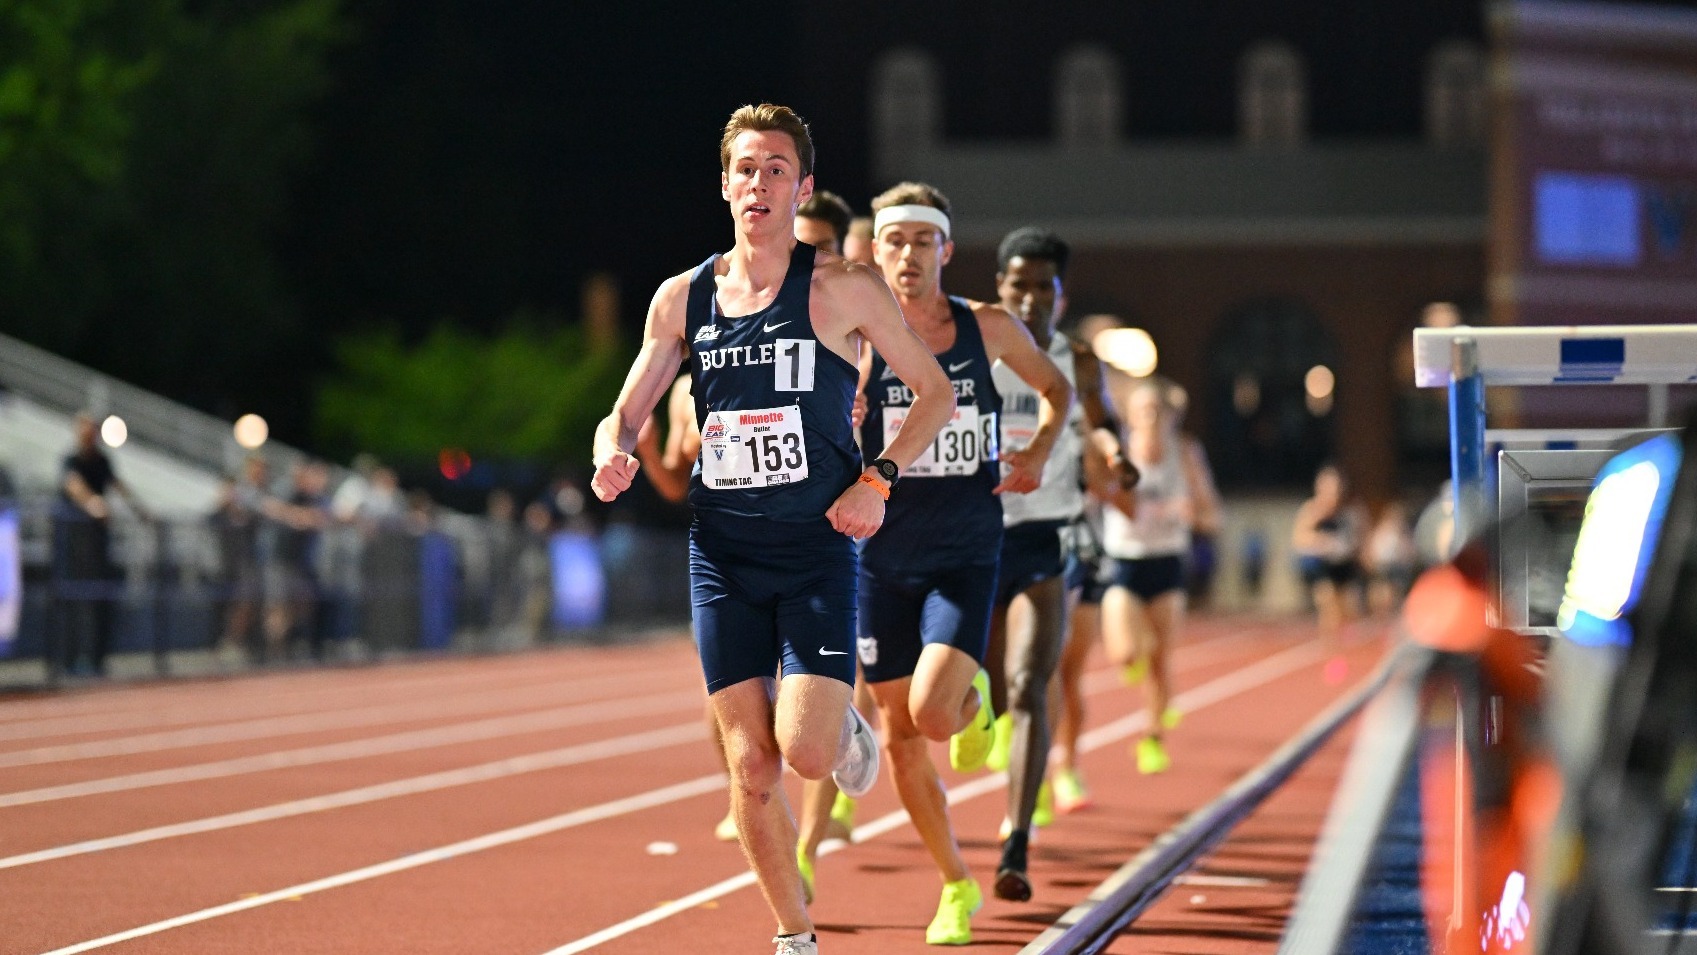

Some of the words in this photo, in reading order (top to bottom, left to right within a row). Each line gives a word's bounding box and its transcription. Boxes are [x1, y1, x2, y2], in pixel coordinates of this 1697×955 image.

[699, 343, 777, 371] BUTLE
[784, 342, 800, 389] 1
[886, 378, 975, 405] BUER
[707, 424, 725, 432] BIG
[739, 412, 784, 426] Minnette
[744, 432, 803, 473] 153
[933, 429, 976, 463] 130
[714, 478, 738, 487] TIMING
[738, 477, 753, 486] TAG
